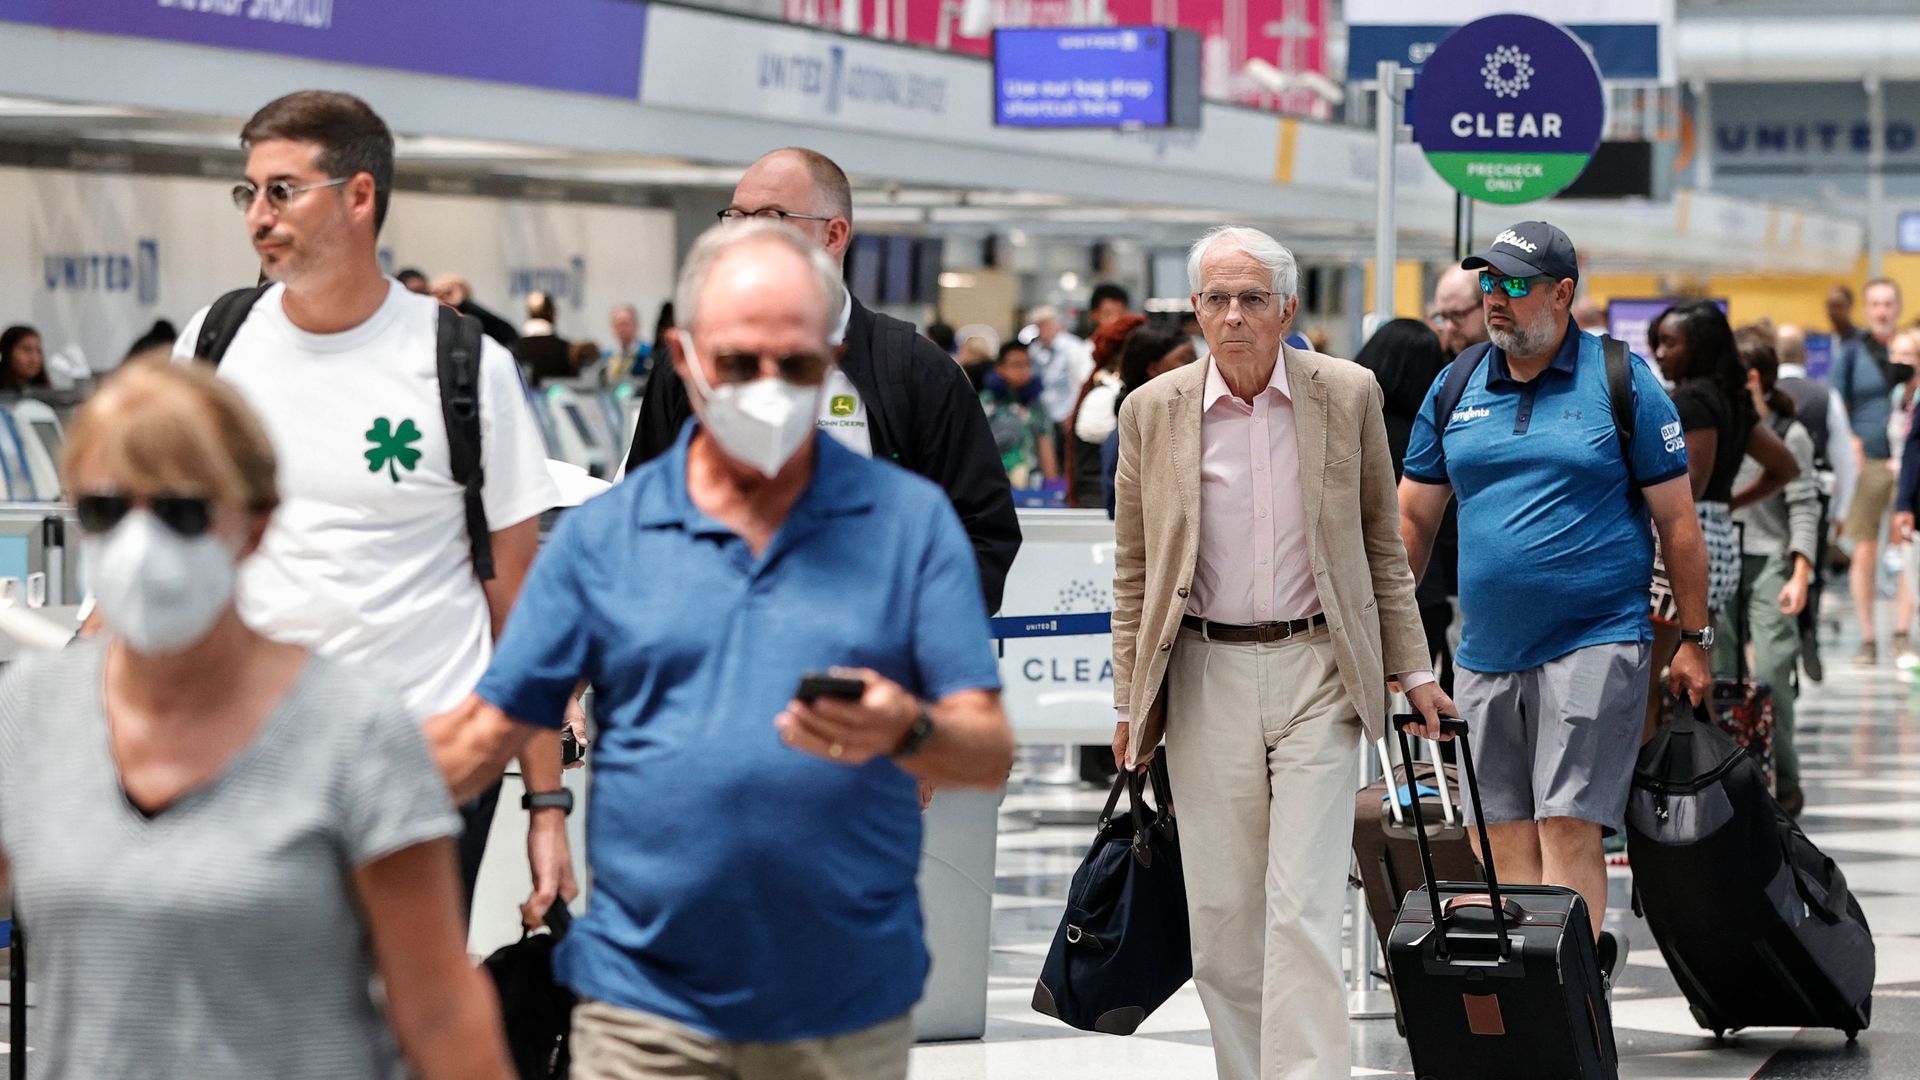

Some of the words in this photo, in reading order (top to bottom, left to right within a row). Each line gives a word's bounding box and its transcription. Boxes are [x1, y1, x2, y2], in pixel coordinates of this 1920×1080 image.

[1450, 112, 1563, 138] CLEAR
[1715, 123, 1916, 152] UNITED
[1466, 163, 1544, 177] PRECHECK
[1485, 179, 1525, 193] ONLY
[44, 255, 131, 291] UNITED
[839, 420, 866, 428] DEERE
[1026, 623, 1050, 631] UNITED
[1023, 658, 1114, 682] CLEA
